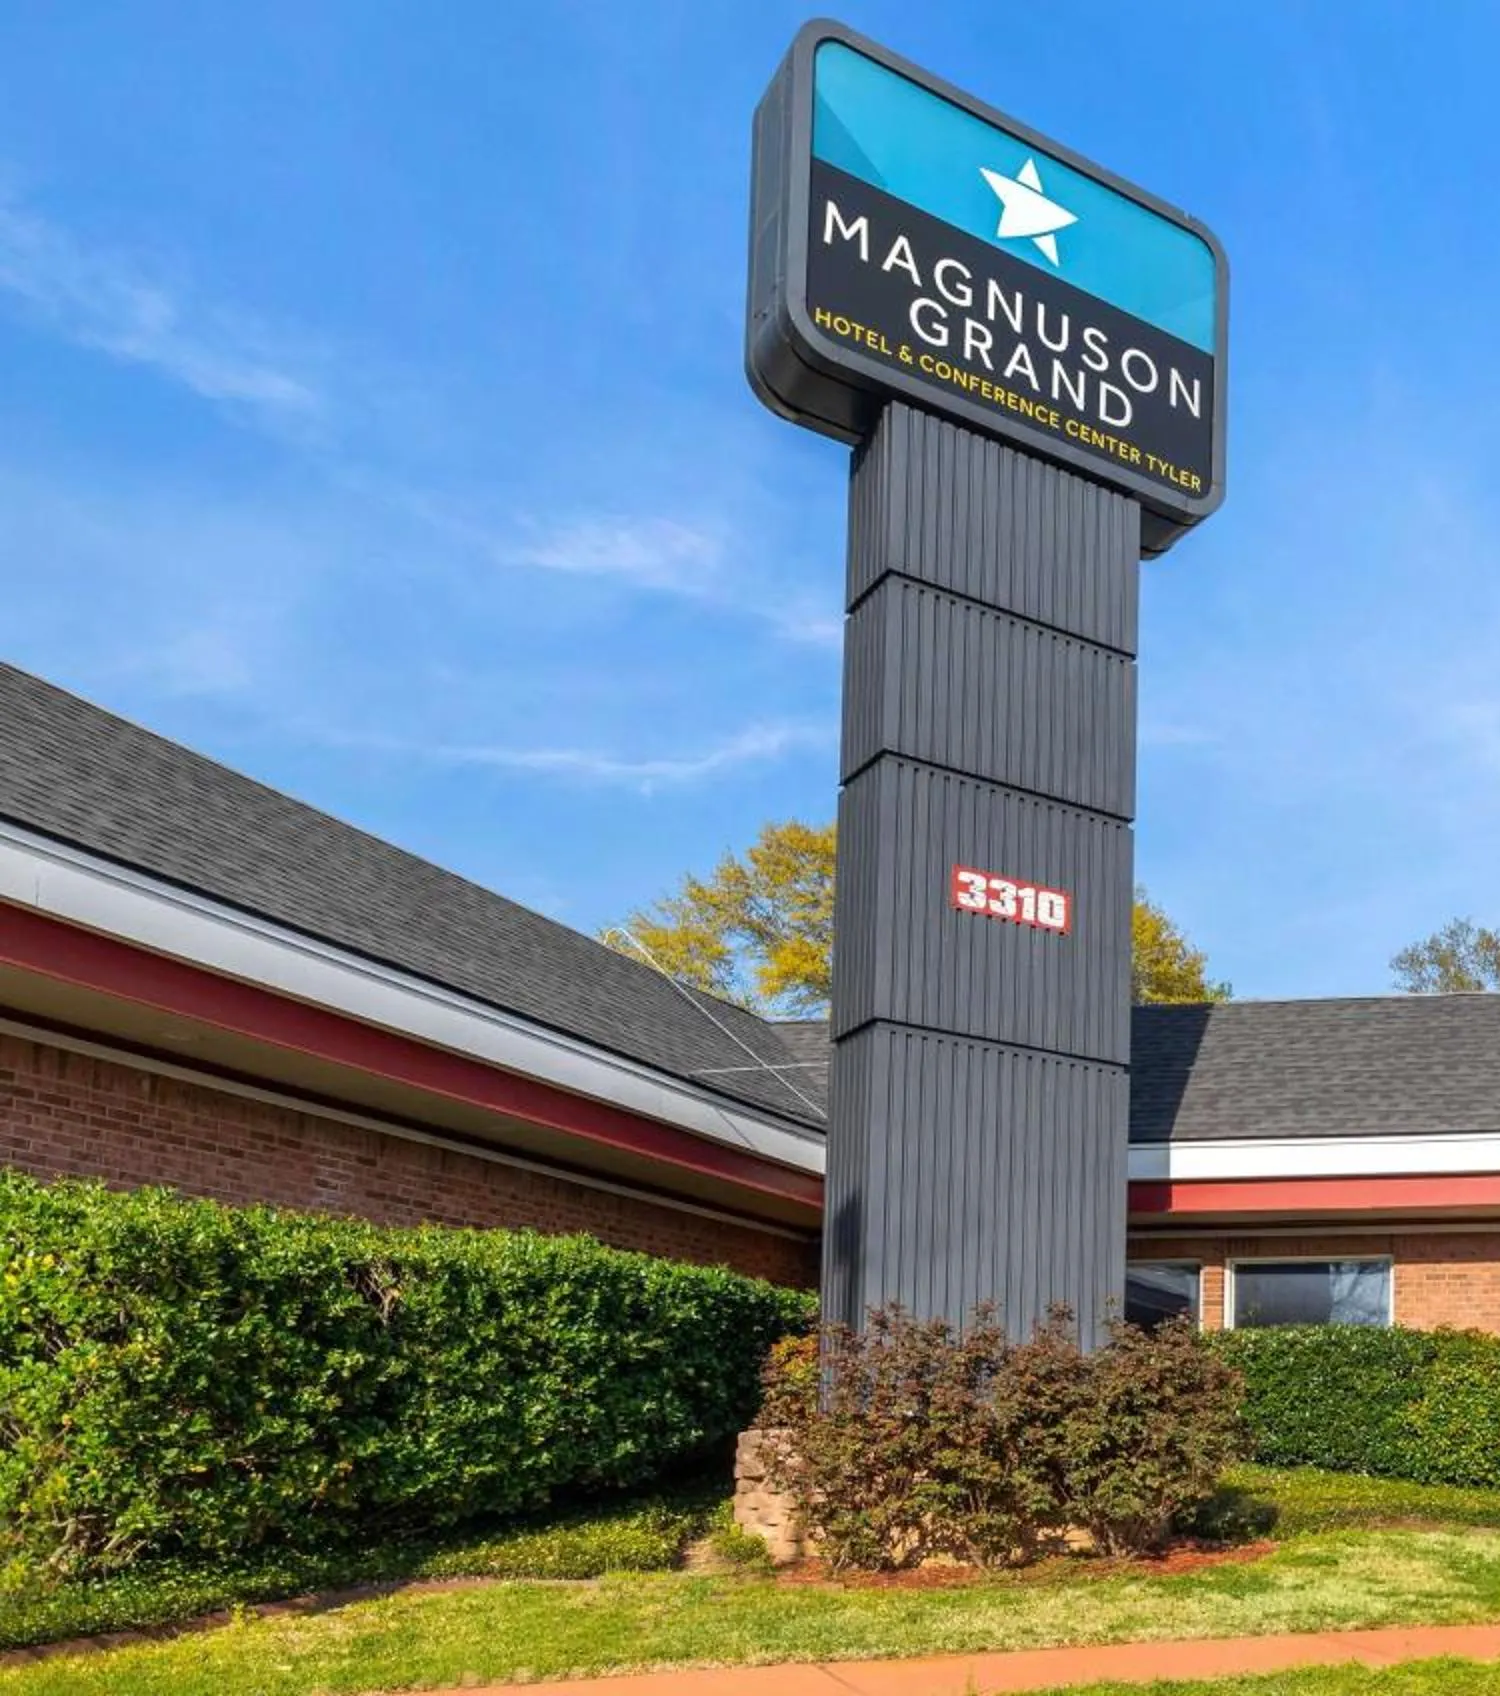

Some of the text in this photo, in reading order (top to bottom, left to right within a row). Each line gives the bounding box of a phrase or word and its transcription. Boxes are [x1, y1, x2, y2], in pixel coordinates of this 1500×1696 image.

[823, 200, 1200, 418] MAGNUSON
[909, 298, 1132, 427] GRAND
[815, 307, 1201, 492] HOTEL & CONFERENCE CENTER TYLER
[957, 871, 1065, 928] 3310
